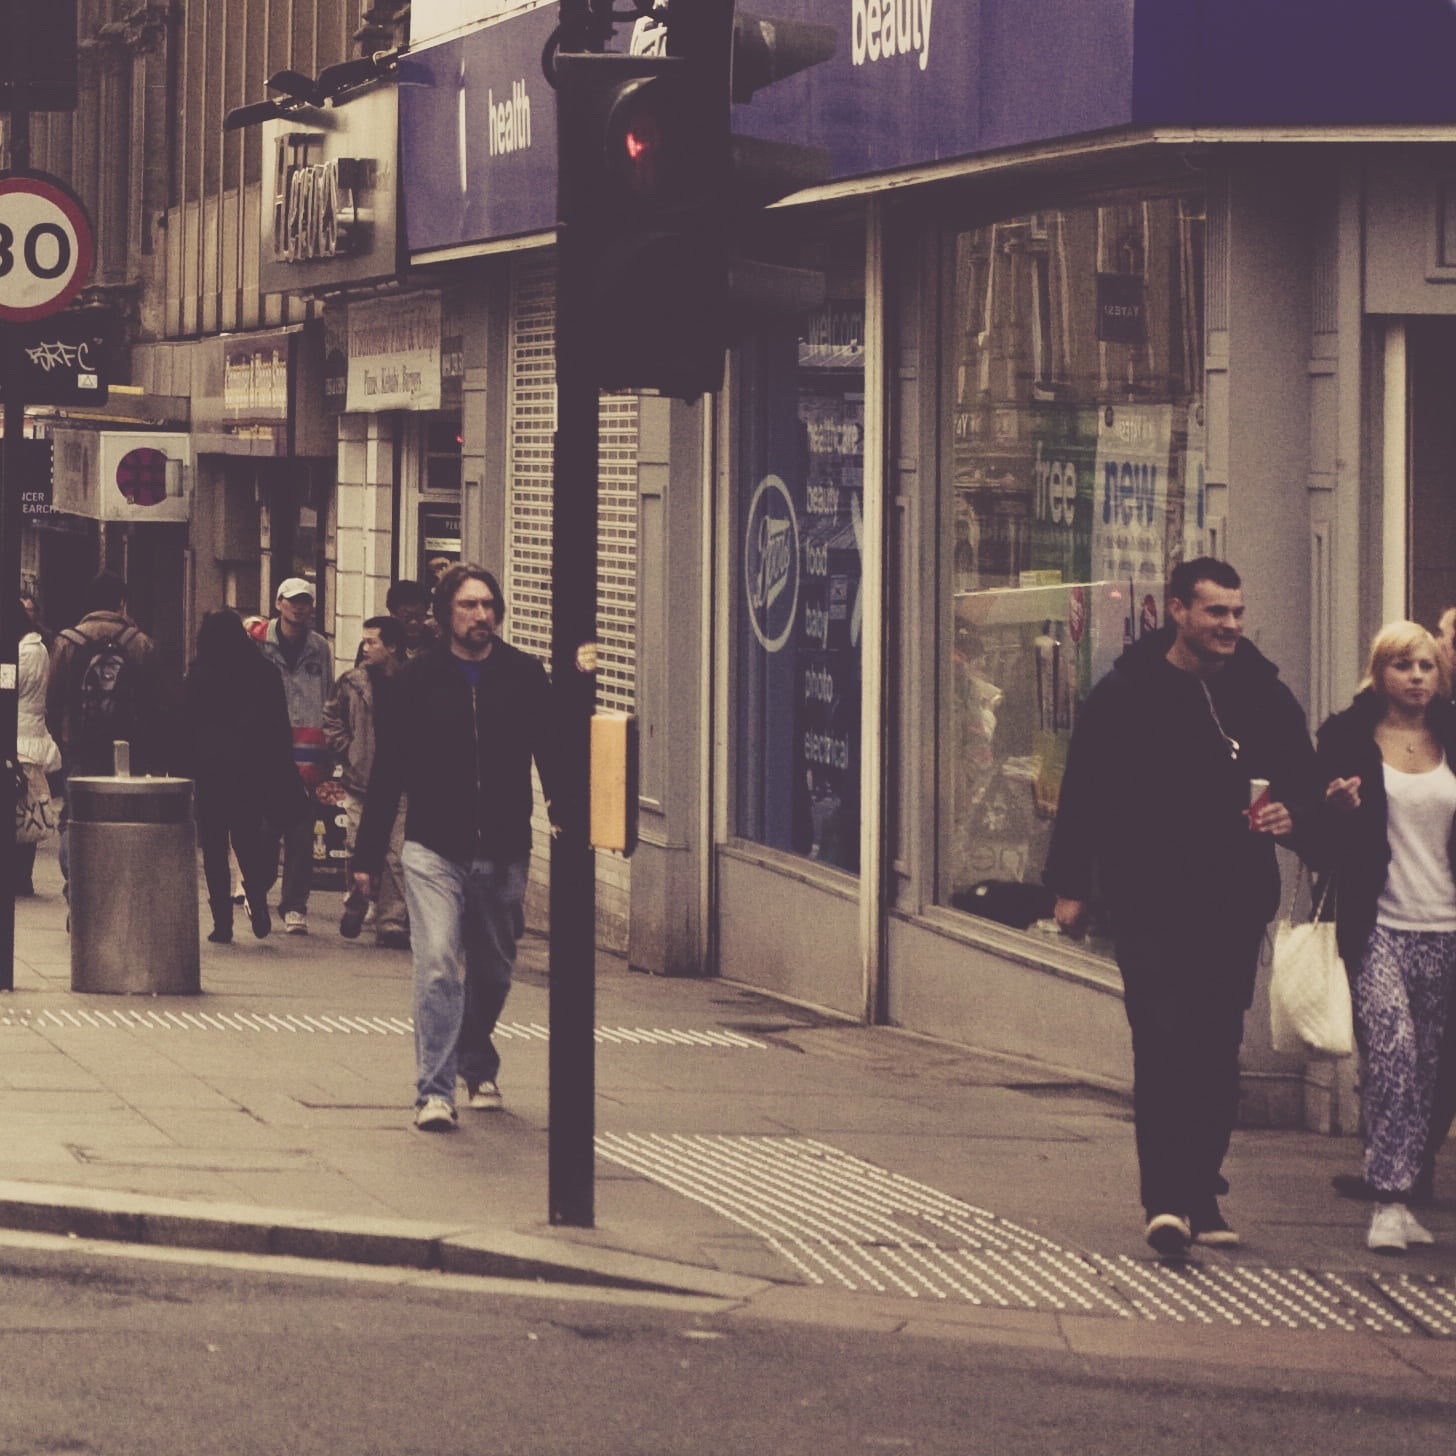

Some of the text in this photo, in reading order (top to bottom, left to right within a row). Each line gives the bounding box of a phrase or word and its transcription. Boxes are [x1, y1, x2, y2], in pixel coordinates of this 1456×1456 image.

[488, 79, 532, 157] health
[807, 480, 839, 526] beauty
[1035, 441, 1076, 525] free
[1103, 461, 1156, 525] new
[806, 537, 828, 576] food
[805, 600, 829, 650] baby
[805, 664, 833, 704] photo
